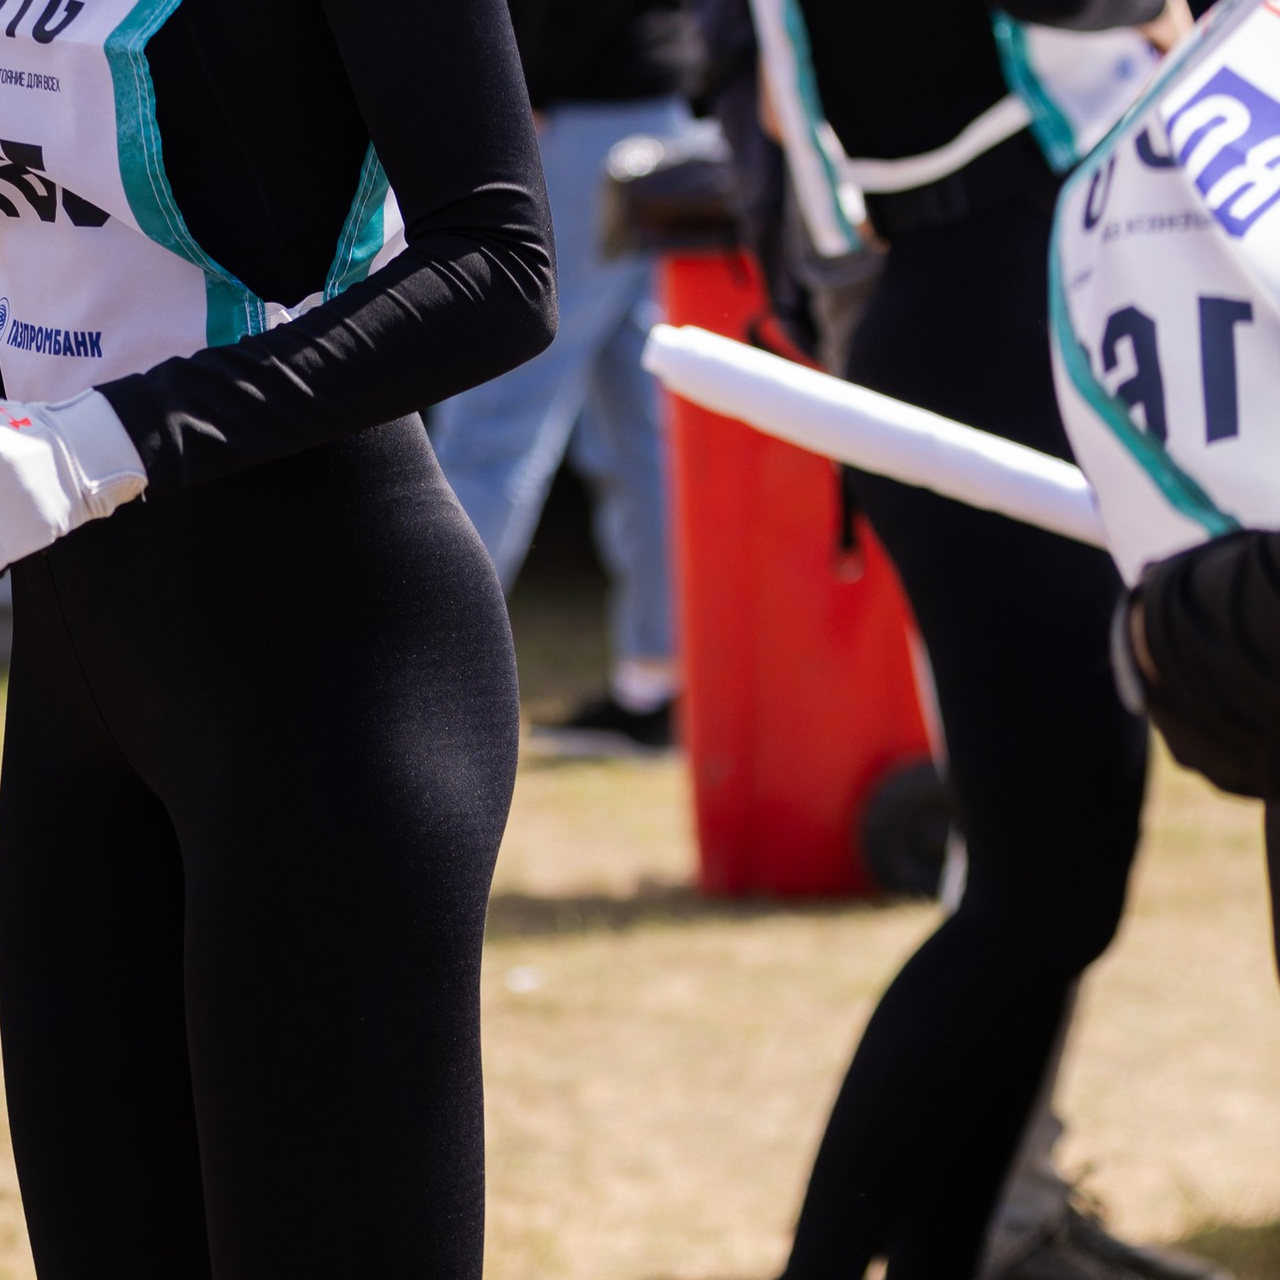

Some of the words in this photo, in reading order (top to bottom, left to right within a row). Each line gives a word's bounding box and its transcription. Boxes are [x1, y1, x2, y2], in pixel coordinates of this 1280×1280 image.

[26, 73, 43, 90] ДЛЯ
[43, 76, 62, 93] ВСЕХ
[7, 318, 102, 358] ГАЗПРОМБАНК
